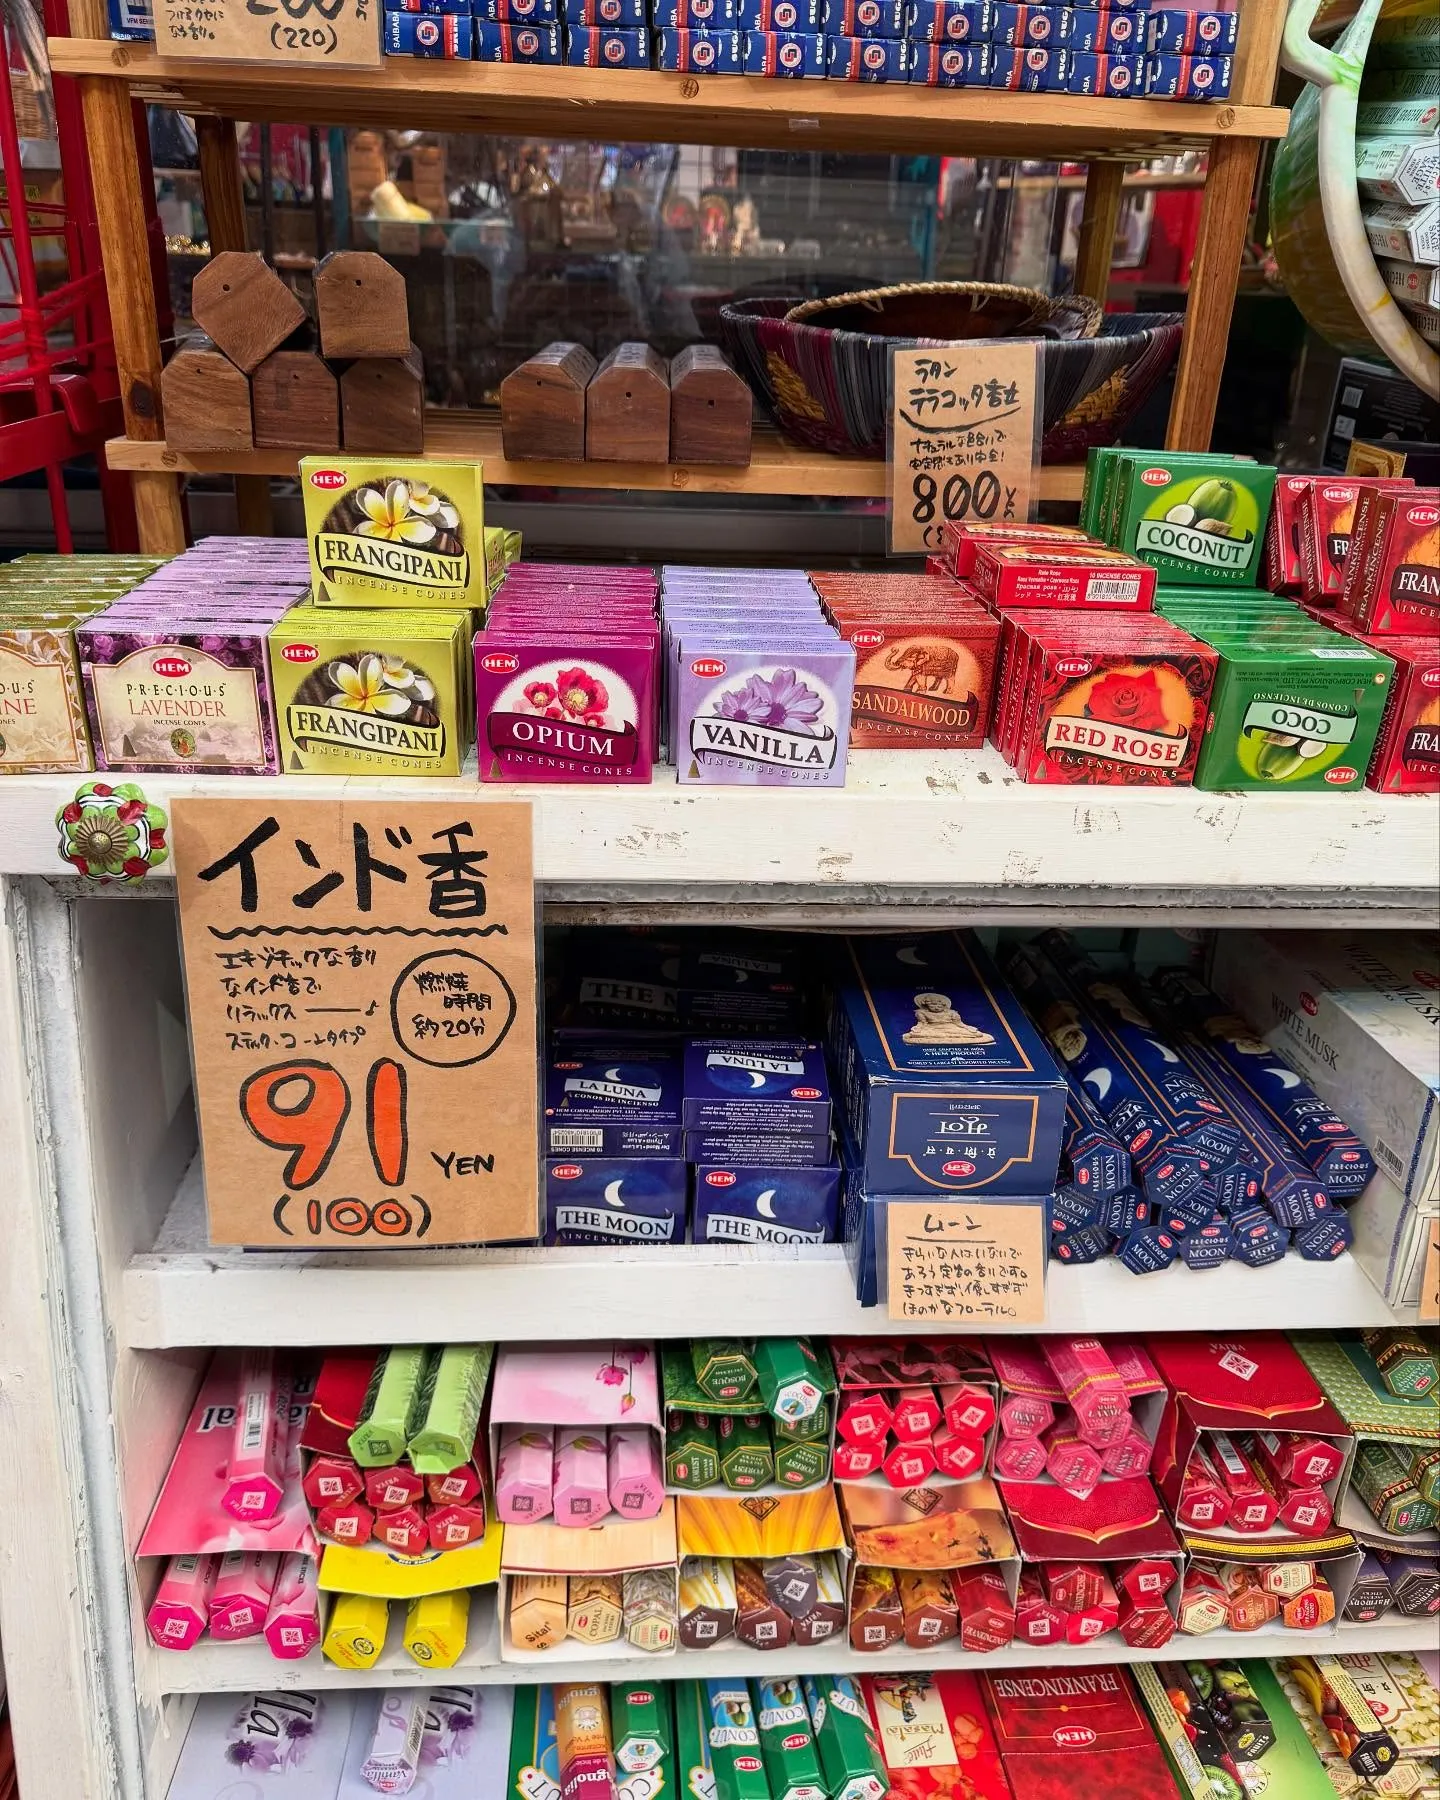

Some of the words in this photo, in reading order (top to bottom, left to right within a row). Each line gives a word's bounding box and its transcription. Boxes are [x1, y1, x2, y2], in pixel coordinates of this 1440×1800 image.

[270, 22, 340, 55] (220)
[313, 473, 346, 487] HEM
[1144, 472, 1170, 482] HEM
[912, 470, 1001, 524] 800
[1326, 490, 1351, 498] HEM
[1409, 512, 1439, 522] HEM
[1147, 526, 1244, 564] COCONUT
[1342, 496, 1371, 602] FRANKINCENSE
[324, 539, 464, 582] FRANGIPANI
[1146, 555, 1199, 573] INCENSE
[1204, 568, 1245, 578] CONES
[1358, 511, 1387, 618] FRANKINCENSE
[336, 576, 408, 595] INCENSE
[413, 586, 467, 600] CONES
[853, 634, 882, 643] HEM
[284, 646, 318, 660] HEM
[484, 657, 517, 669] HEM
[155, 662, 190, 674] HEM
[692, 662, 724, 674] HEM
[1058, 663, 1089, 673] HEM
[129, 699, 226, 718] LAVENDER
[852, 691, 970, 727] SANDALWOOD
[1253, 692, 1299, 703] INCIENSO
[1300, 697, 1314, 707] DE
[1315, 699, 1348, 712] CONOS
[296, 710, 438, 754] FRANGIPANI
[859, 722, 919, 737] INCENSE
[925, 732, 969, 741] CONES
[1271, 708, 1331, 735] COCO
[512, 721, 615, 757] OPIUM
[702, 723, 825, 764] VANILLA
[1055, 723, 1106, 748] RED
[1113, 735, 1179, 761] ROSE
[311, 746, 383, 764] INCENSE
[390, 757, 442, 769] CONES
[507, 752, 576, 772] INCENSE
[582, 763, 633, 776] CONES
[707, 756, 774, 778] INCENSE
[780, 767, 830, 780] CONES
[1058, 754, 1122, 773] INCENSE
[1129, 765, 1178, 778] CONES
[1326, 770, 1356, 782] HEM
[198, 816, 489, 919] インド香
[215, 945, 376, 969] エキゾチックな香り
[220, 972, 322, 998] なインド香で
[414, 973, 469, 993] 燃焼
[444, 994, 492, 1011] 時間
[414, 1014, 487, 1038] 約20分
[1271, 992, 1304, 1038] WHITE
[1305, 1027, 1340, 1072] MUSK
[722, 1055, 758, 1070] LUNA
[773, 1062, 790, 1072] LA
[574, 1093, 603, 1101] CONOS
[617, 1098, 659, 1107] INCIENSO
[579, 1081, 599, 1091] LA
[603, 1082, 646, 1098] LUNA
[793, 1089, 822, 1098] HEM
[240, 1057, 408, 1190] 91
[1198, 1134, 1233, 1155] MOON
[430, 1151, 494, 1178] YEN
[554, 1167, 580, 1176] HEM
[1105, 1154, 1116, 1190] MOON
[708, 1174, 735, 1183] HEM
[1165, 1170, 1199, 1201] MOON
[1328, 1173, 1366, 1184] MOON
[273, 1193, 432, 1238] (100)
[1057, 1194, 1092, 1217] MOON
[1110, 1195, 1120, 1228] MOON
[561, 1210, 601, 1226] THE
[605, 1215, 669, 1237] MOON
[712, 1219, 751, 1236] THE
[755, 1223, 820, 1244] MOON
[924, 1213, 983, 1234] ムーン
[1306, 1221, 1338, 1252] MOON
[1131, 1243, 1159, 1270] MOON
[1188, 1247, 1227, 1258] MOON
[712, 1374, 747, 1386] BOSQUE
[995, 1672, 1121, 1698] FRANKINCENSE
[629, 1692, 651, 1703] HEM
[784, 1735, 808, 1748] HEM
[1057, 1732, 1094, 1742] HEM
[736, 1757, 761, 1769] HEM
